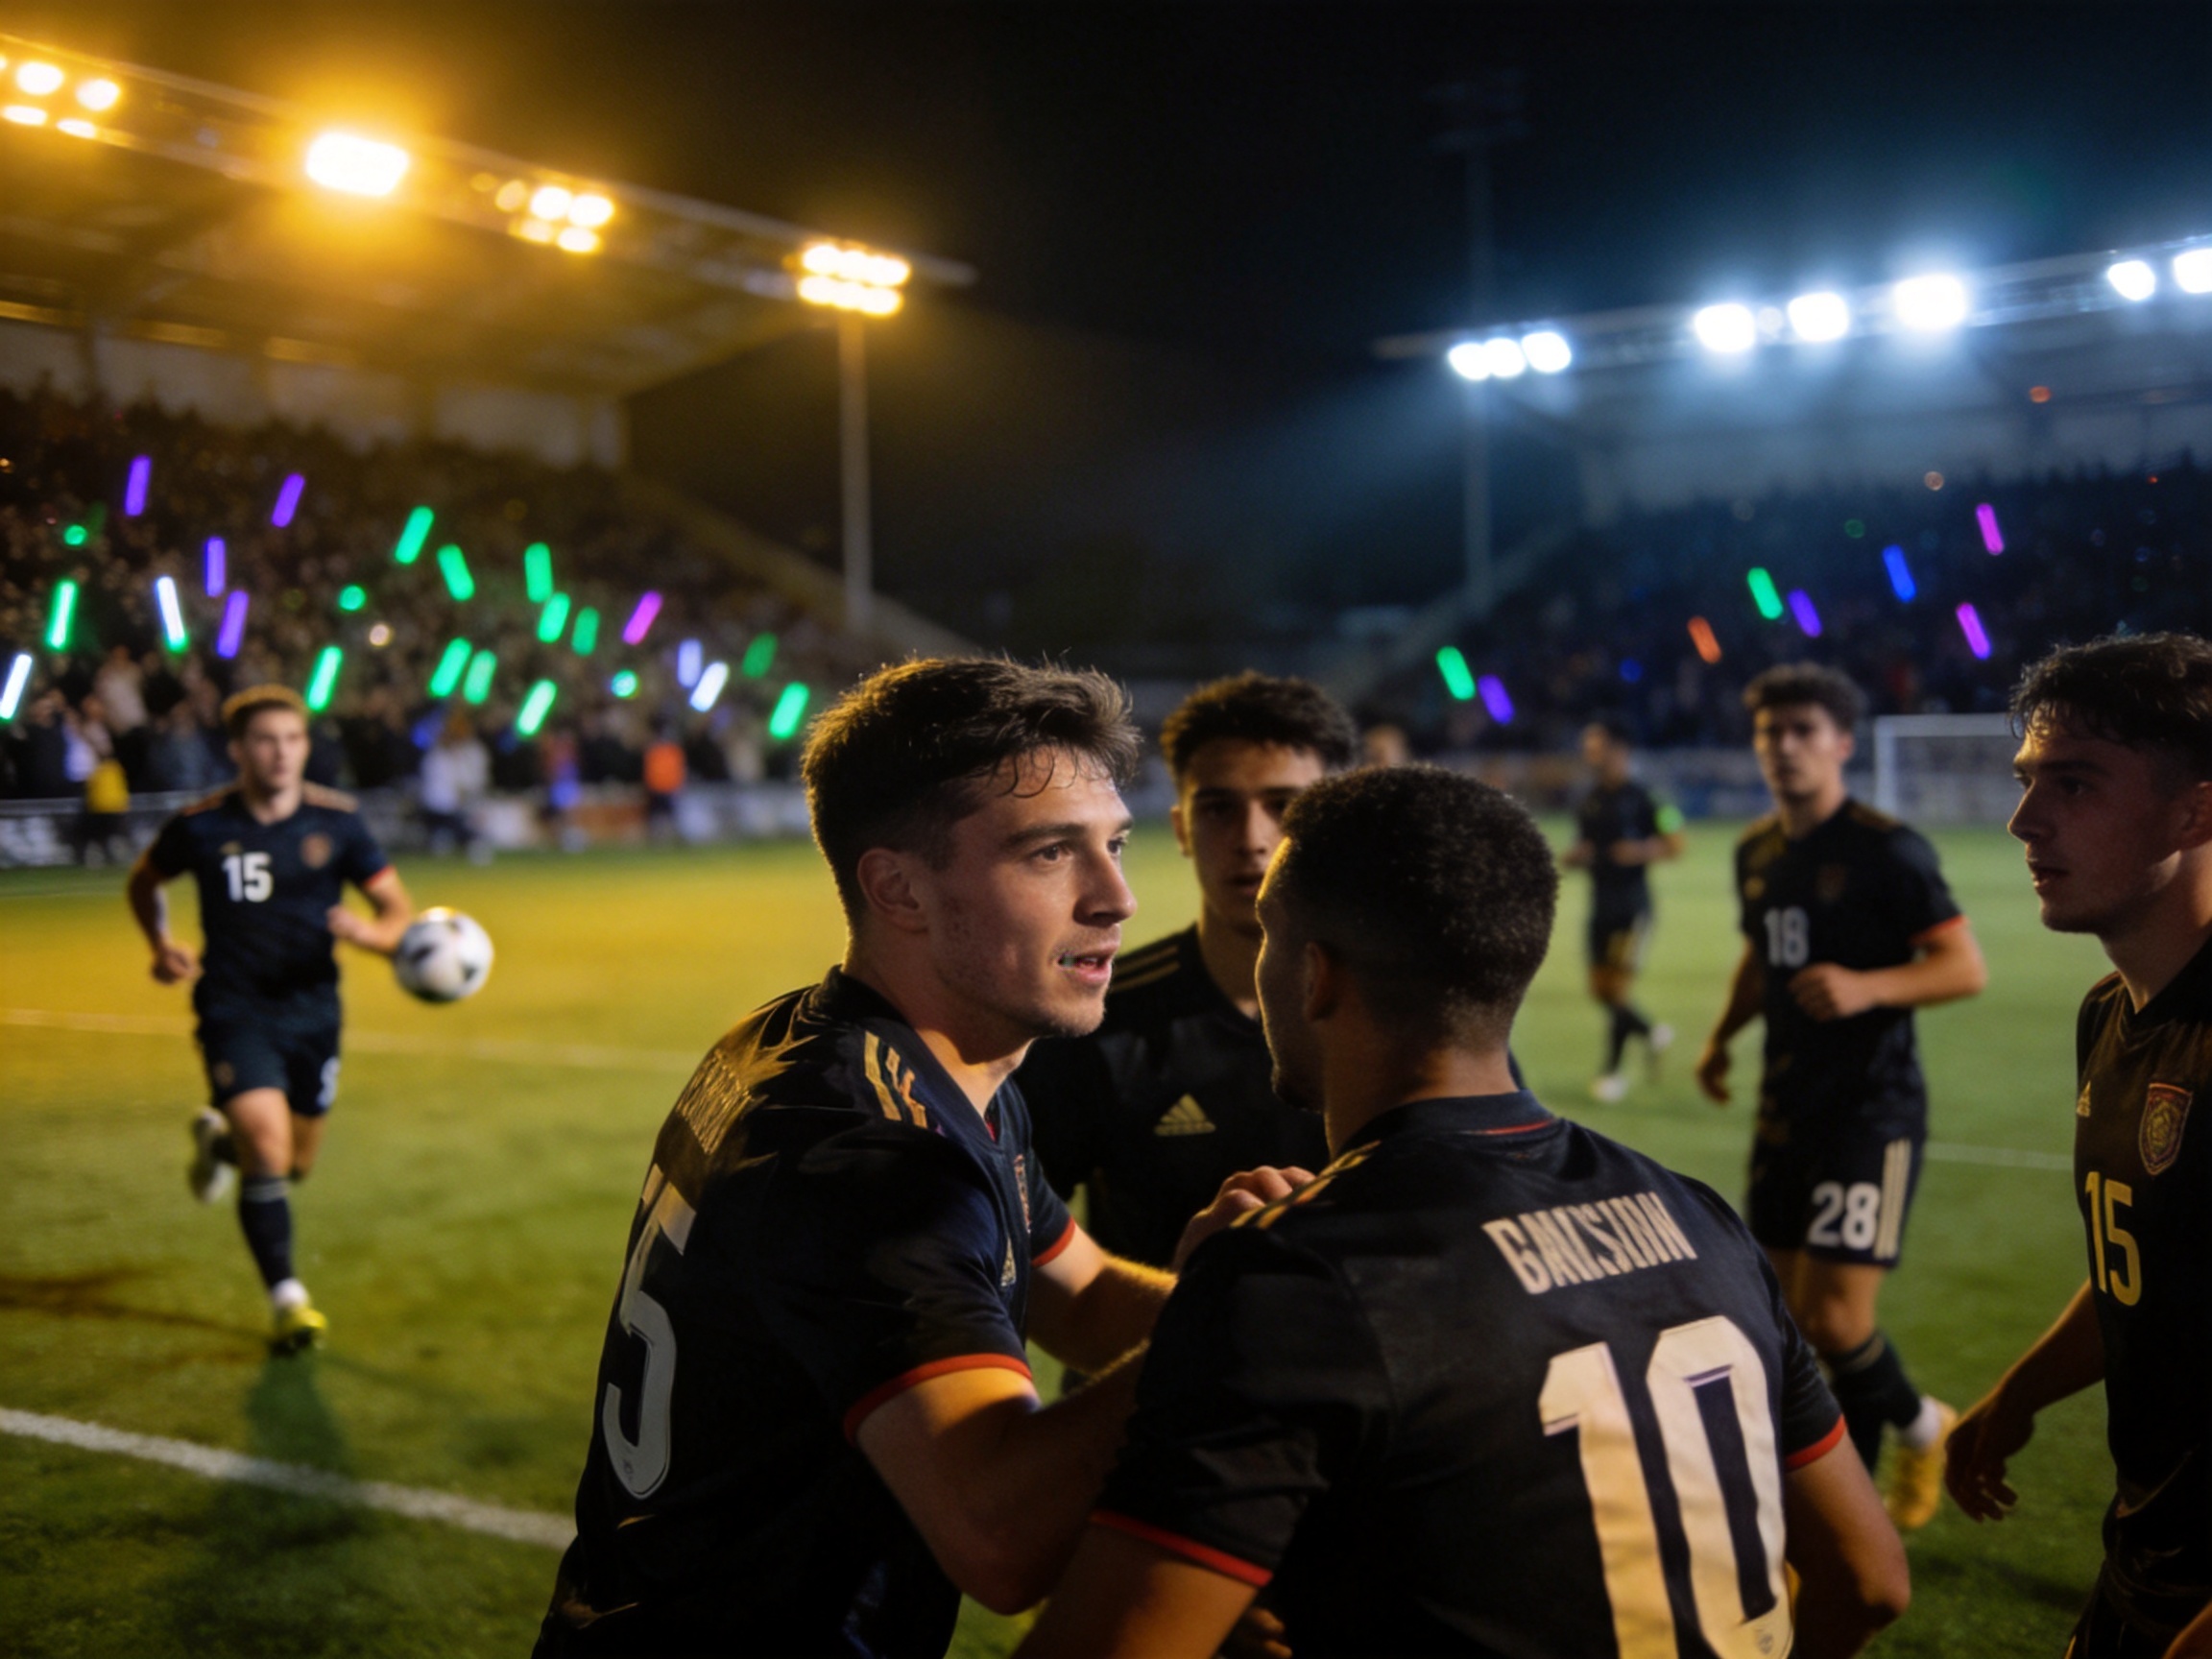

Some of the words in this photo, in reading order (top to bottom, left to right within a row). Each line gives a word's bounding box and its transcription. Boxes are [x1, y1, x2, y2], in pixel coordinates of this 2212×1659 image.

[223, 854, 273, 902] 15
[1764, 906, 1810, 967] 18
[1809, 1182, 1881, 1249] 28
[2085, 1170, 2142, 1307] 15
[603, 1163, 696, 1500] 5
[1538, 1314, 1794, 1659] 10
